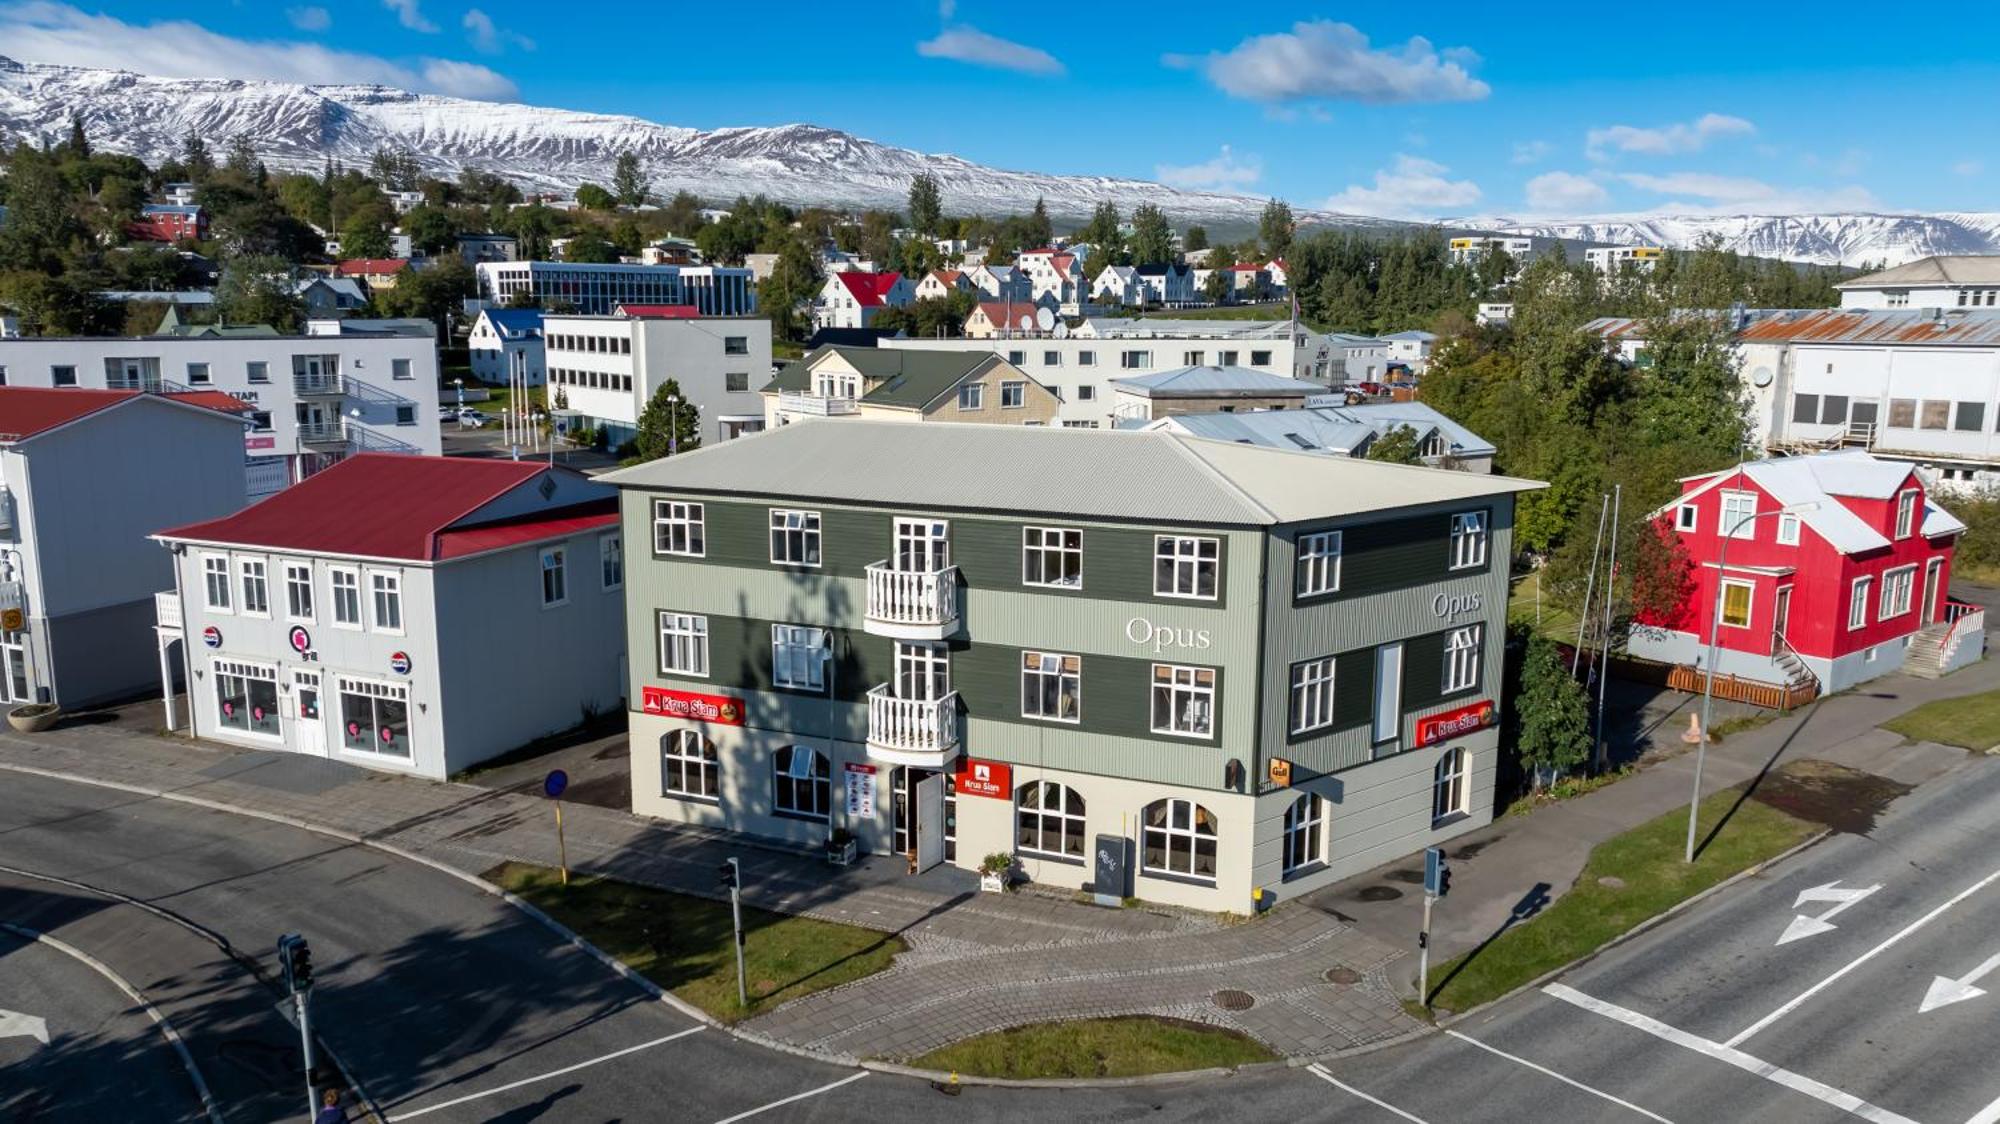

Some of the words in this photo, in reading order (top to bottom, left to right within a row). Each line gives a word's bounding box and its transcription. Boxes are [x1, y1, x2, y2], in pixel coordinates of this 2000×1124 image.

[1432, 592, 1481, 624] Opus
[1127, 617, 1211, 653] Opus
[662, 695, 689, 714] Krua
[690, 699, 719, 718] Siam
[1272, 766, 1288, 777] Gull
[965, 779, 982, 790] Krua
[983, 782, 1000, 793] Siam
